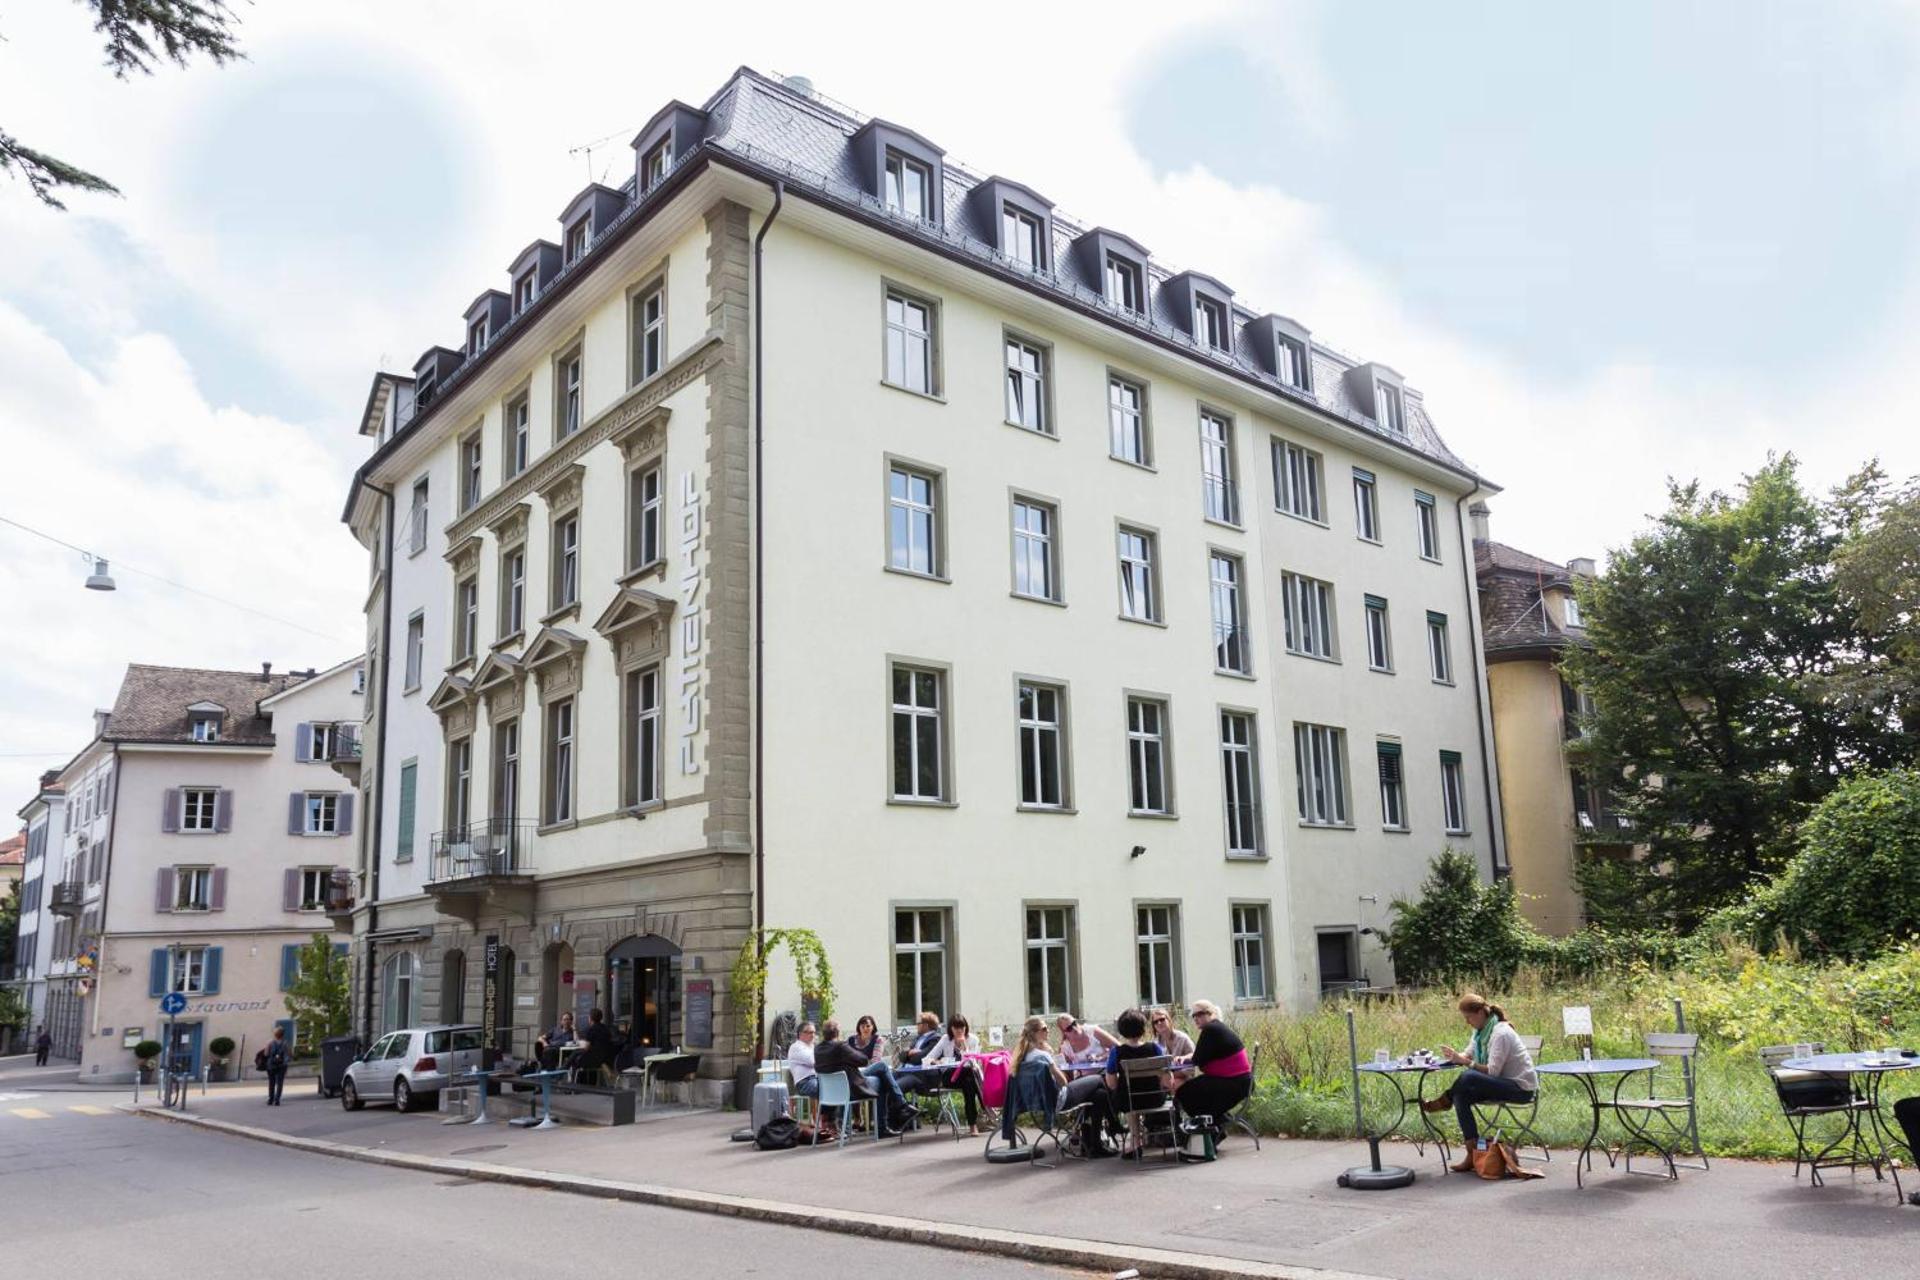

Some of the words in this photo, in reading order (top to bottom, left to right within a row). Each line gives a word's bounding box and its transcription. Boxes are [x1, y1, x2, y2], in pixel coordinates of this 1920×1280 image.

[680, 472, 700, 776] PLATTENHOF
[487, 942, 498, 971] HOTEL
[158, 999, 270, 1014] staurant
